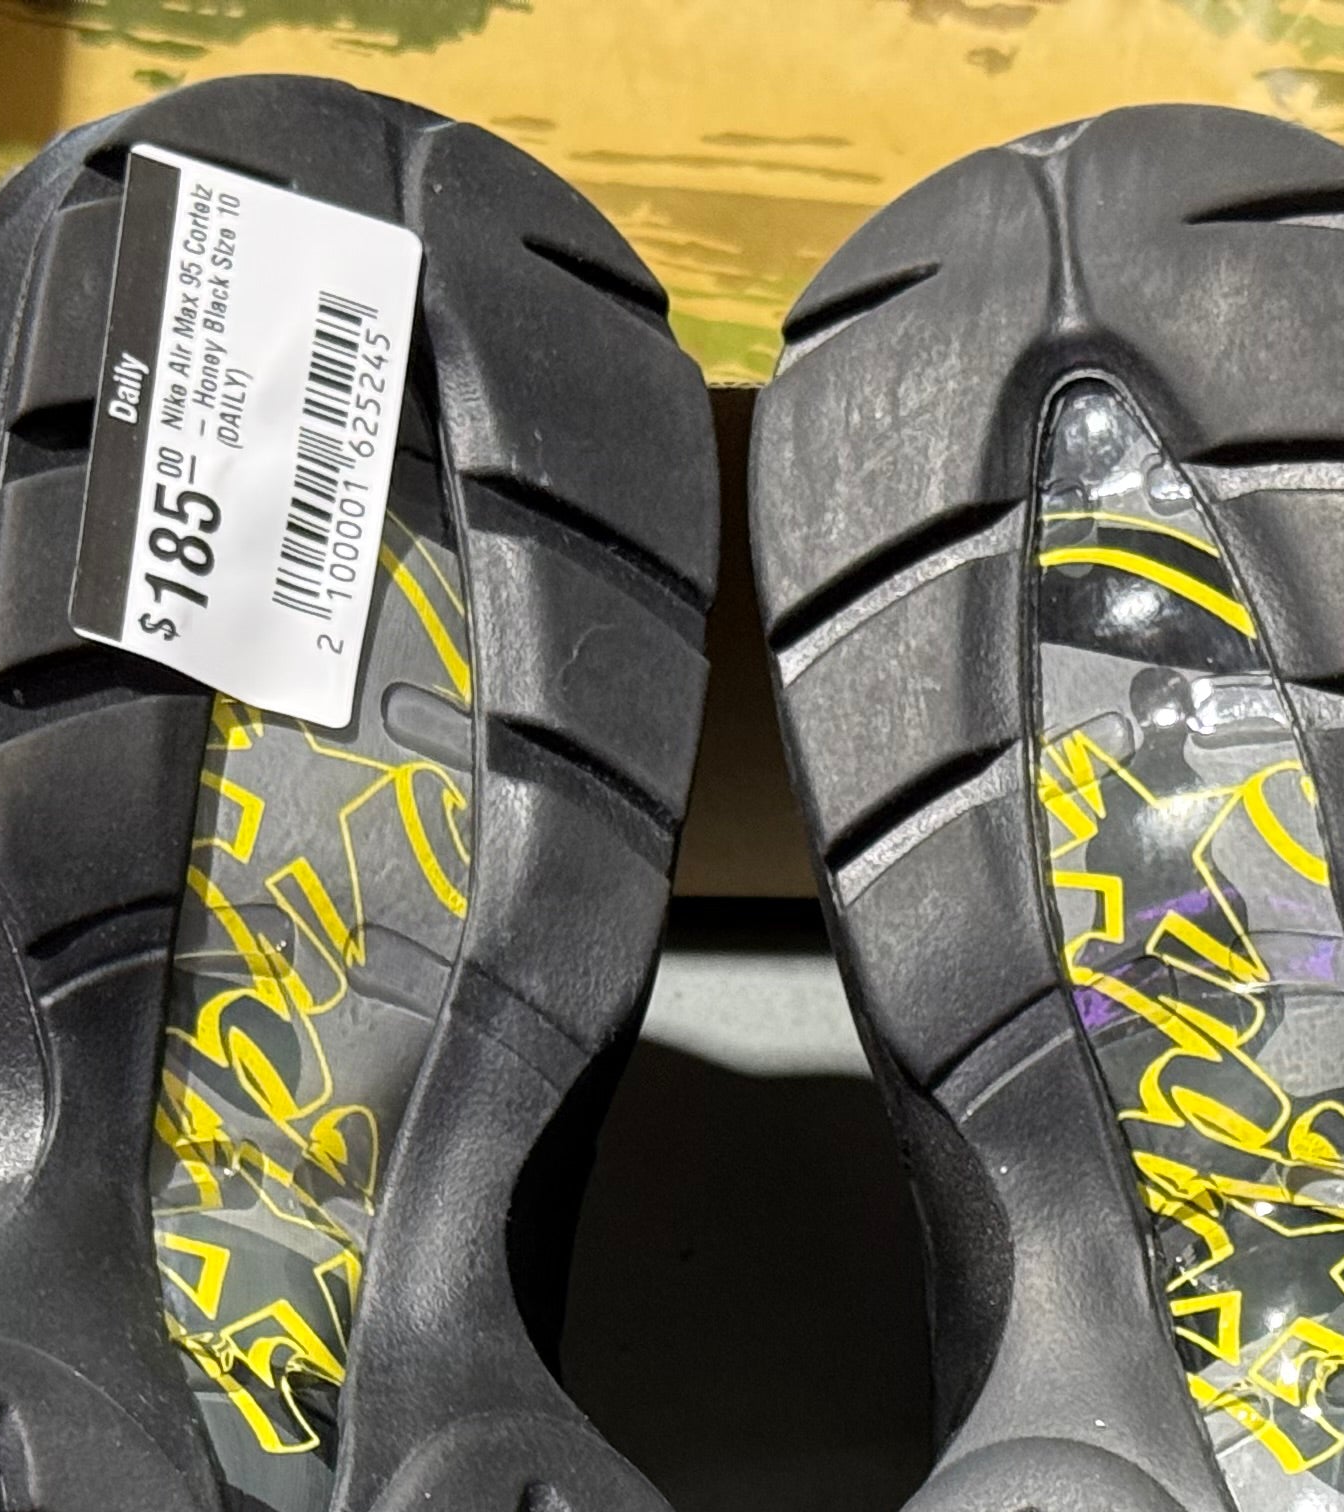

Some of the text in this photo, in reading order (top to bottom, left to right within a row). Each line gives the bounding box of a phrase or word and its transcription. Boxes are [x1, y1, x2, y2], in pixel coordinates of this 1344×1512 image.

[216, 193, 241, 216] 10
[210, 228, 237, 270] Size
[160, 183, 213, 430] Nike Air Max 95 Corteiz
[202, 274, 230, 334] Black
[108, 352, 150, 424] Daily
[192, 338, 227, 409] Honey
[216, 368, 254, 449] (DAILY)
[317, 328, 391, 654] 2 100001 625245
